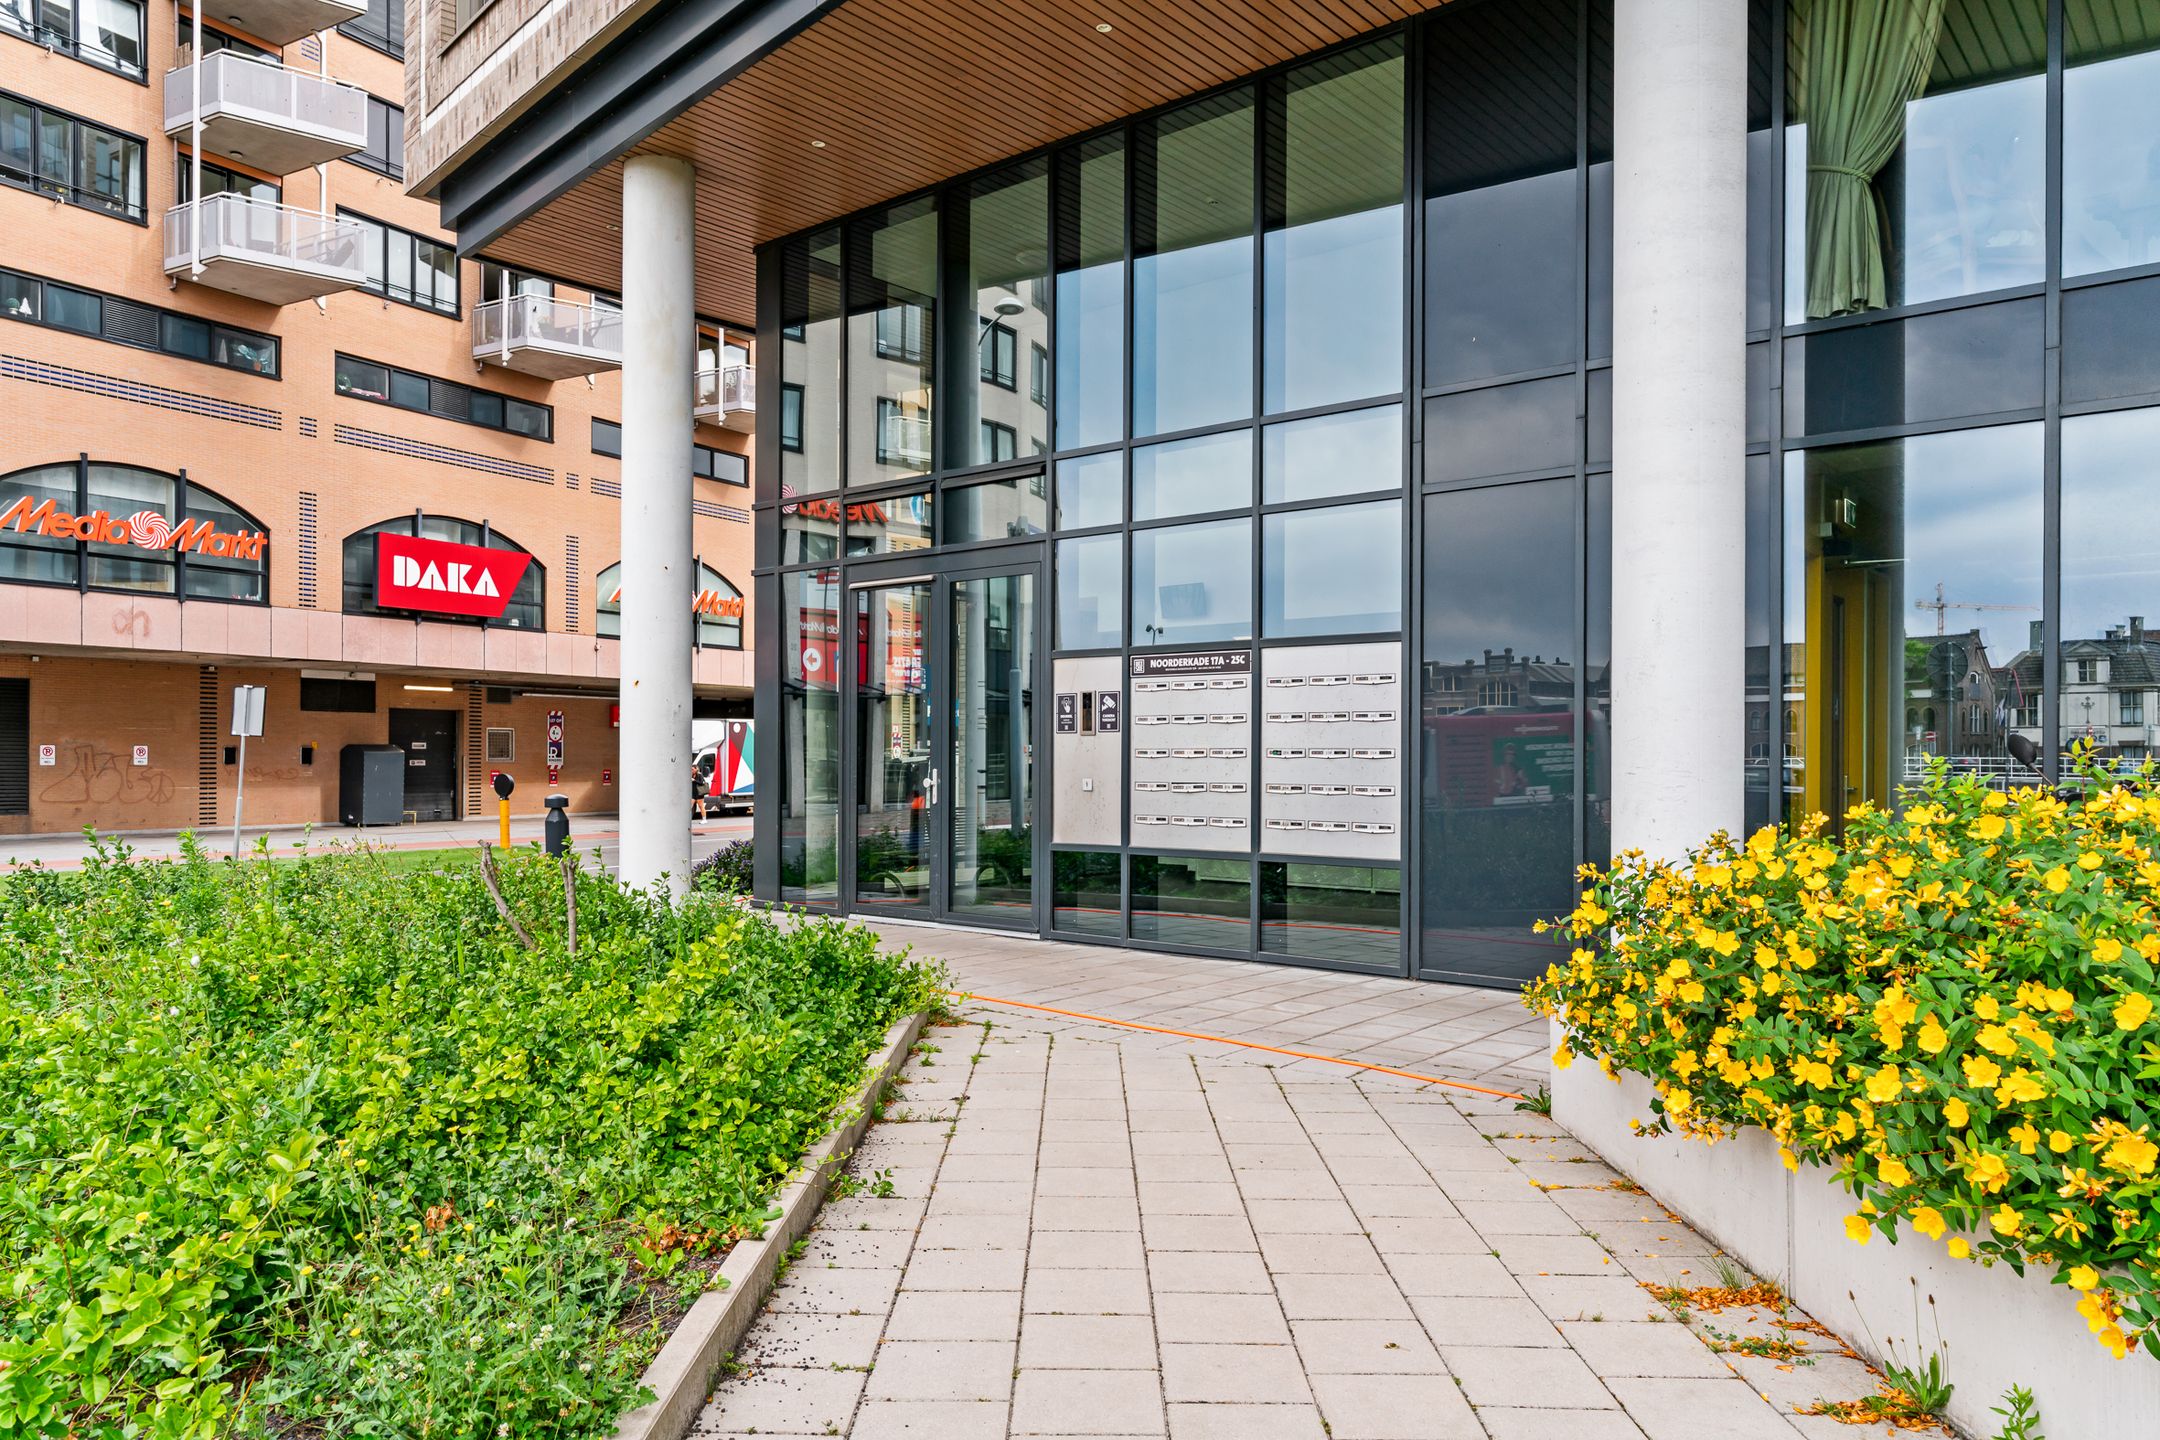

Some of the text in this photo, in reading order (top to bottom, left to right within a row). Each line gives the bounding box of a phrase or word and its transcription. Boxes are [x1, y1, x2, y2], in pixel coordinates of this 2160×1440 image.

[0, 495, 268, 561] Media Markt
[393, 555, 500, 598] DAKA
[692, 589, 745, 618] Markt
[1150, 657, 1209, 668] NOORDERKADE
[1210, 656, 1224, 665] 17A
[1231, 655, 1245, 664] 25C
